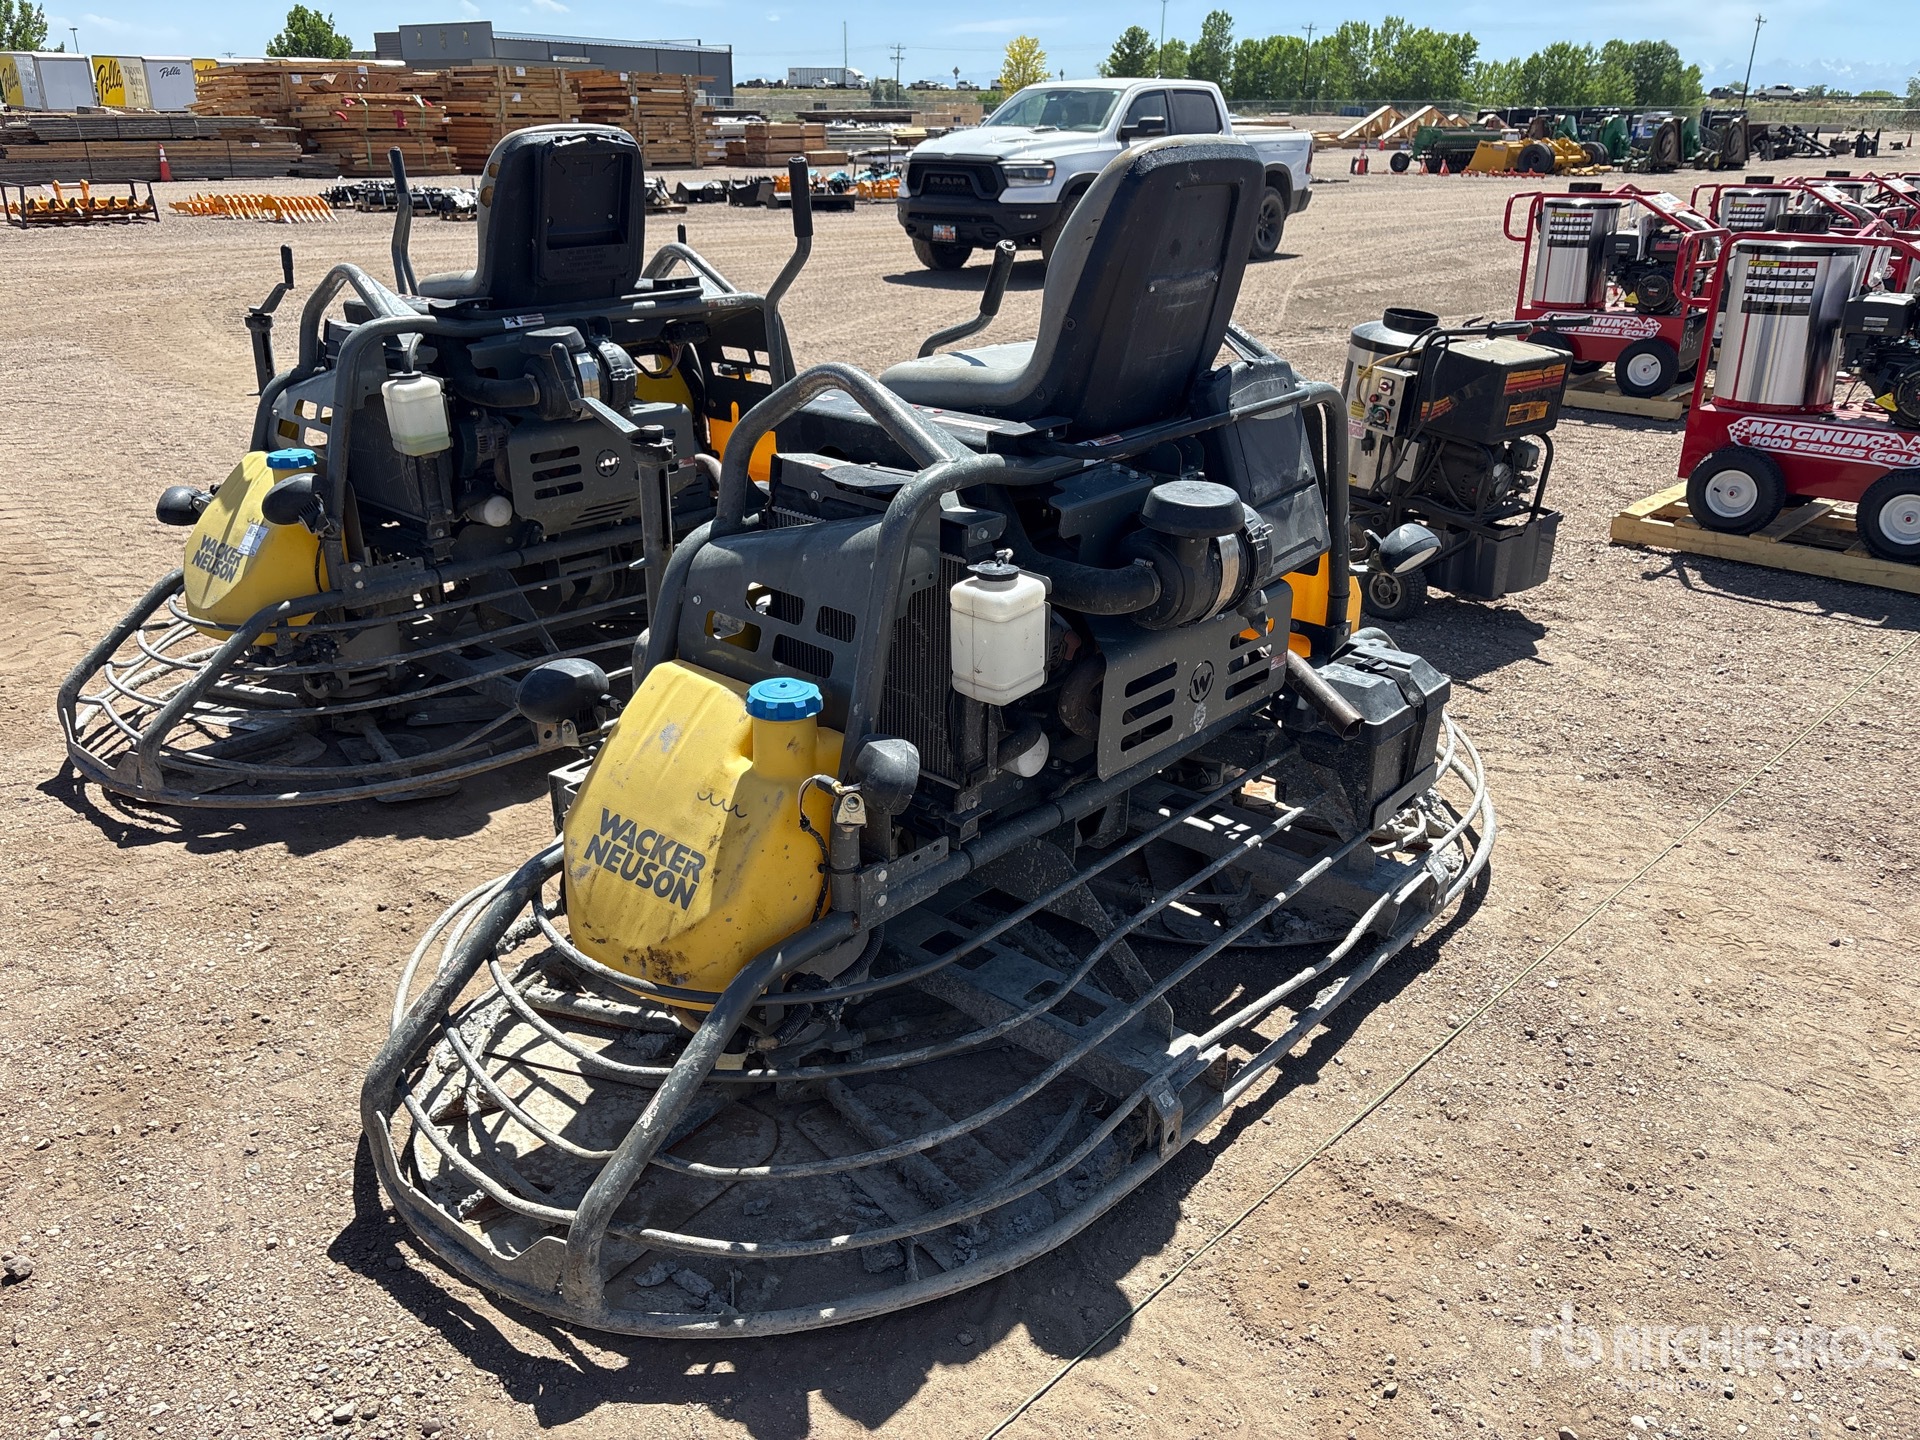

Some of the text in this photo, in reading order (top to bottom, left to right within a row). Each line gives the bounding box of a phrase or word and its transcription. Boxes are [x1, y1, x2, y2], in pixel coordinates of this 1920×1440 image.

[96, 59, 124, 97] Pella
[159, 66, 182, 79] Pella
[930, 177, 966, 185] RAM
[1578, 325, 1620, 334] SERIES
[1623, 329, 1654, 337] GOLD
[1749, 421, 1876, 447] MAGNUM
[1750, 436, 1867, 458] 4000 SERIES
[1872, 451, 1920, 466] GOLD
[200, 534, 244, 567] WACKER
[191, 549, 237, 583] NEUSON
[598, 807, 706, 883] WACKER
[583, 834, 698, 911] NEUSON
